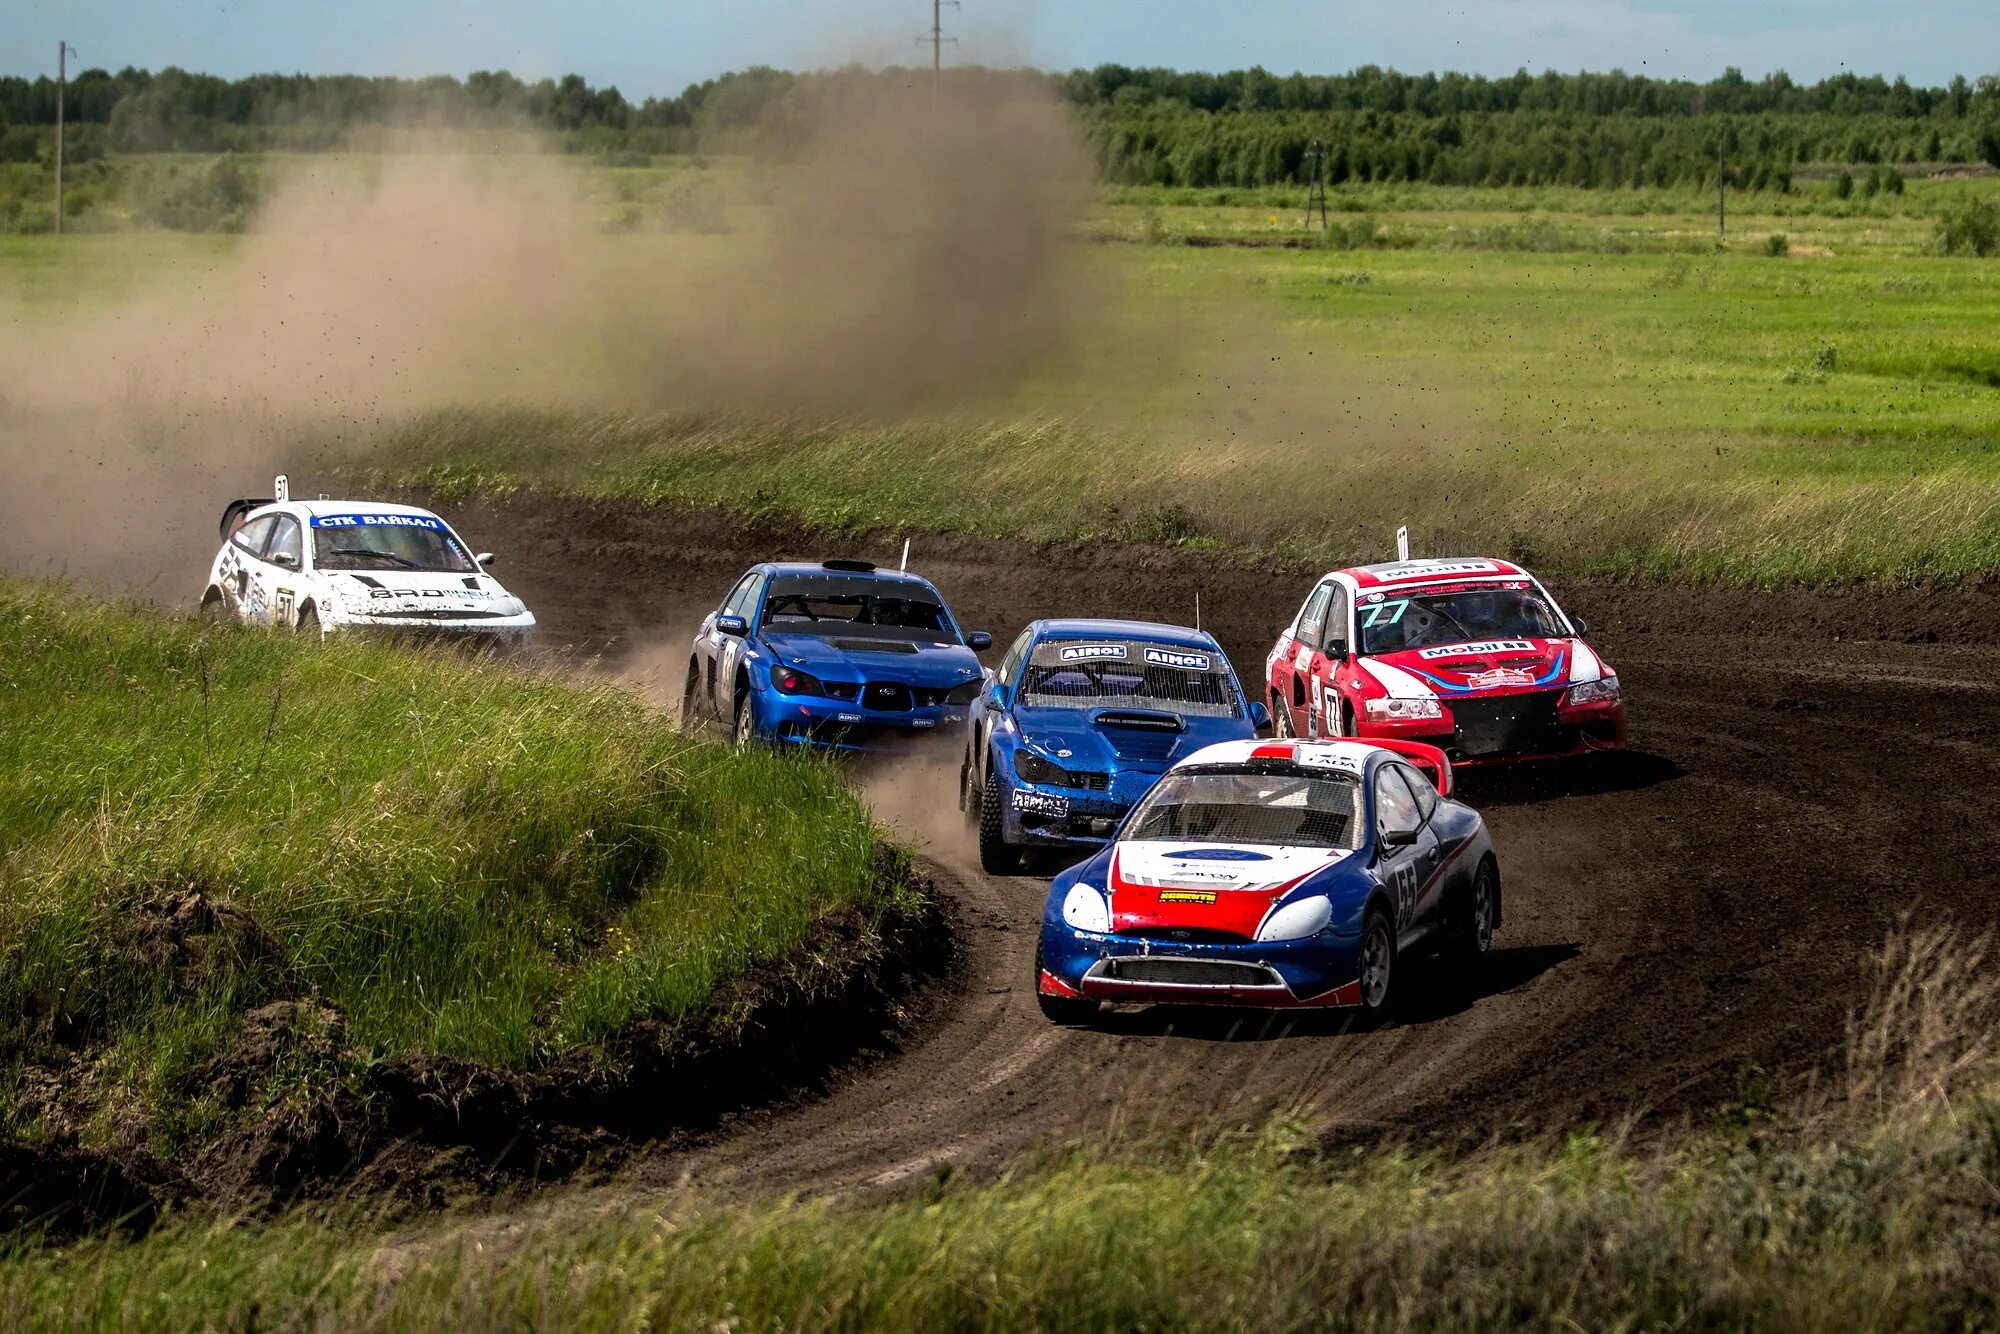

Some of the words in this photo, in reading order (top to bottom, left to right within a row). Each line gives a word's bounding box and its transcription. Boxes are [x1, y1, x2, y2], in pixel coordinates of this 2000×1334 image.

[319, 517, 357, 527] СТК
[363, 515, 438, 528] БАЙКАЛ
[1386, 564, 1457, 578] Mobil
[1357, 600, 1409, 629] 77
[1063, 647, 1124, 659] AIMOL
[1425, 643, 1499, 657] Mobil
[1147, 651, 1207, 667] AIMOL
[1326, 694, 1339, 734] 77
[1397, 865, 1416, 930] 55
